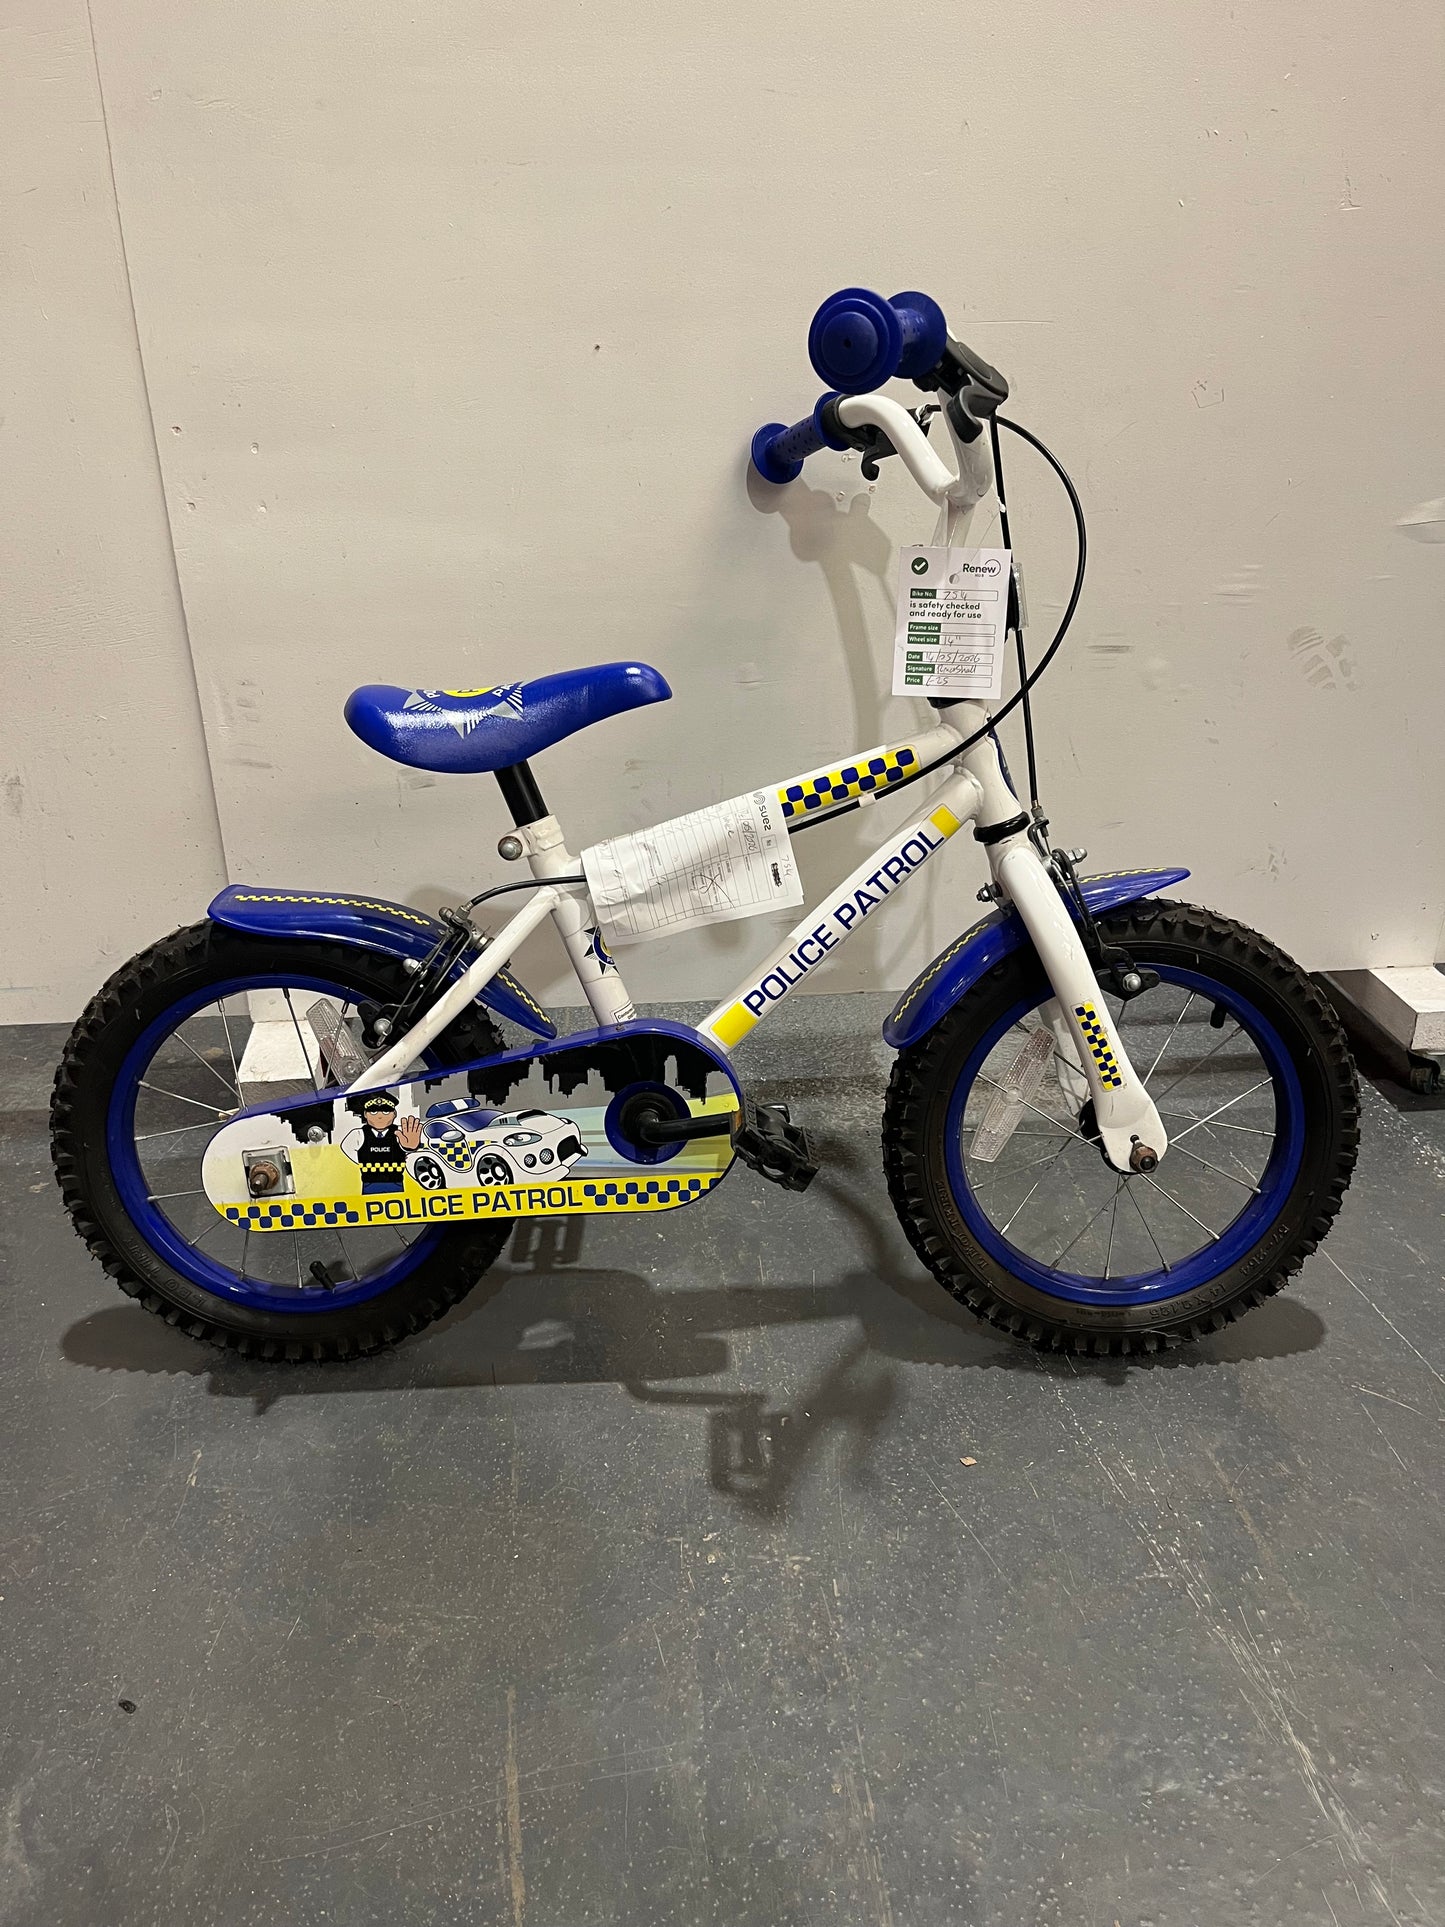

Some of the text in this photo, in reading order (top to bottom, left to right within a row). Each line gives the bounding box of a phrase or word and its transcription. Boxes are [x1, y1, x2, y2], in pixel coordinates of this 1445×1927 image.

[963, 563, 996, 574] Renew
[943, 591, 967, 601] 754
[919, 601, 944, 610] safety
[946, 602, 980, 610] checked
[928, 610, 952, 619] ready
[758, 805, 772, 831] suez
[743, 831, 944, 1017] POLICE PATROL
[366, 1186, 583, 1221] POLICE PATROL
